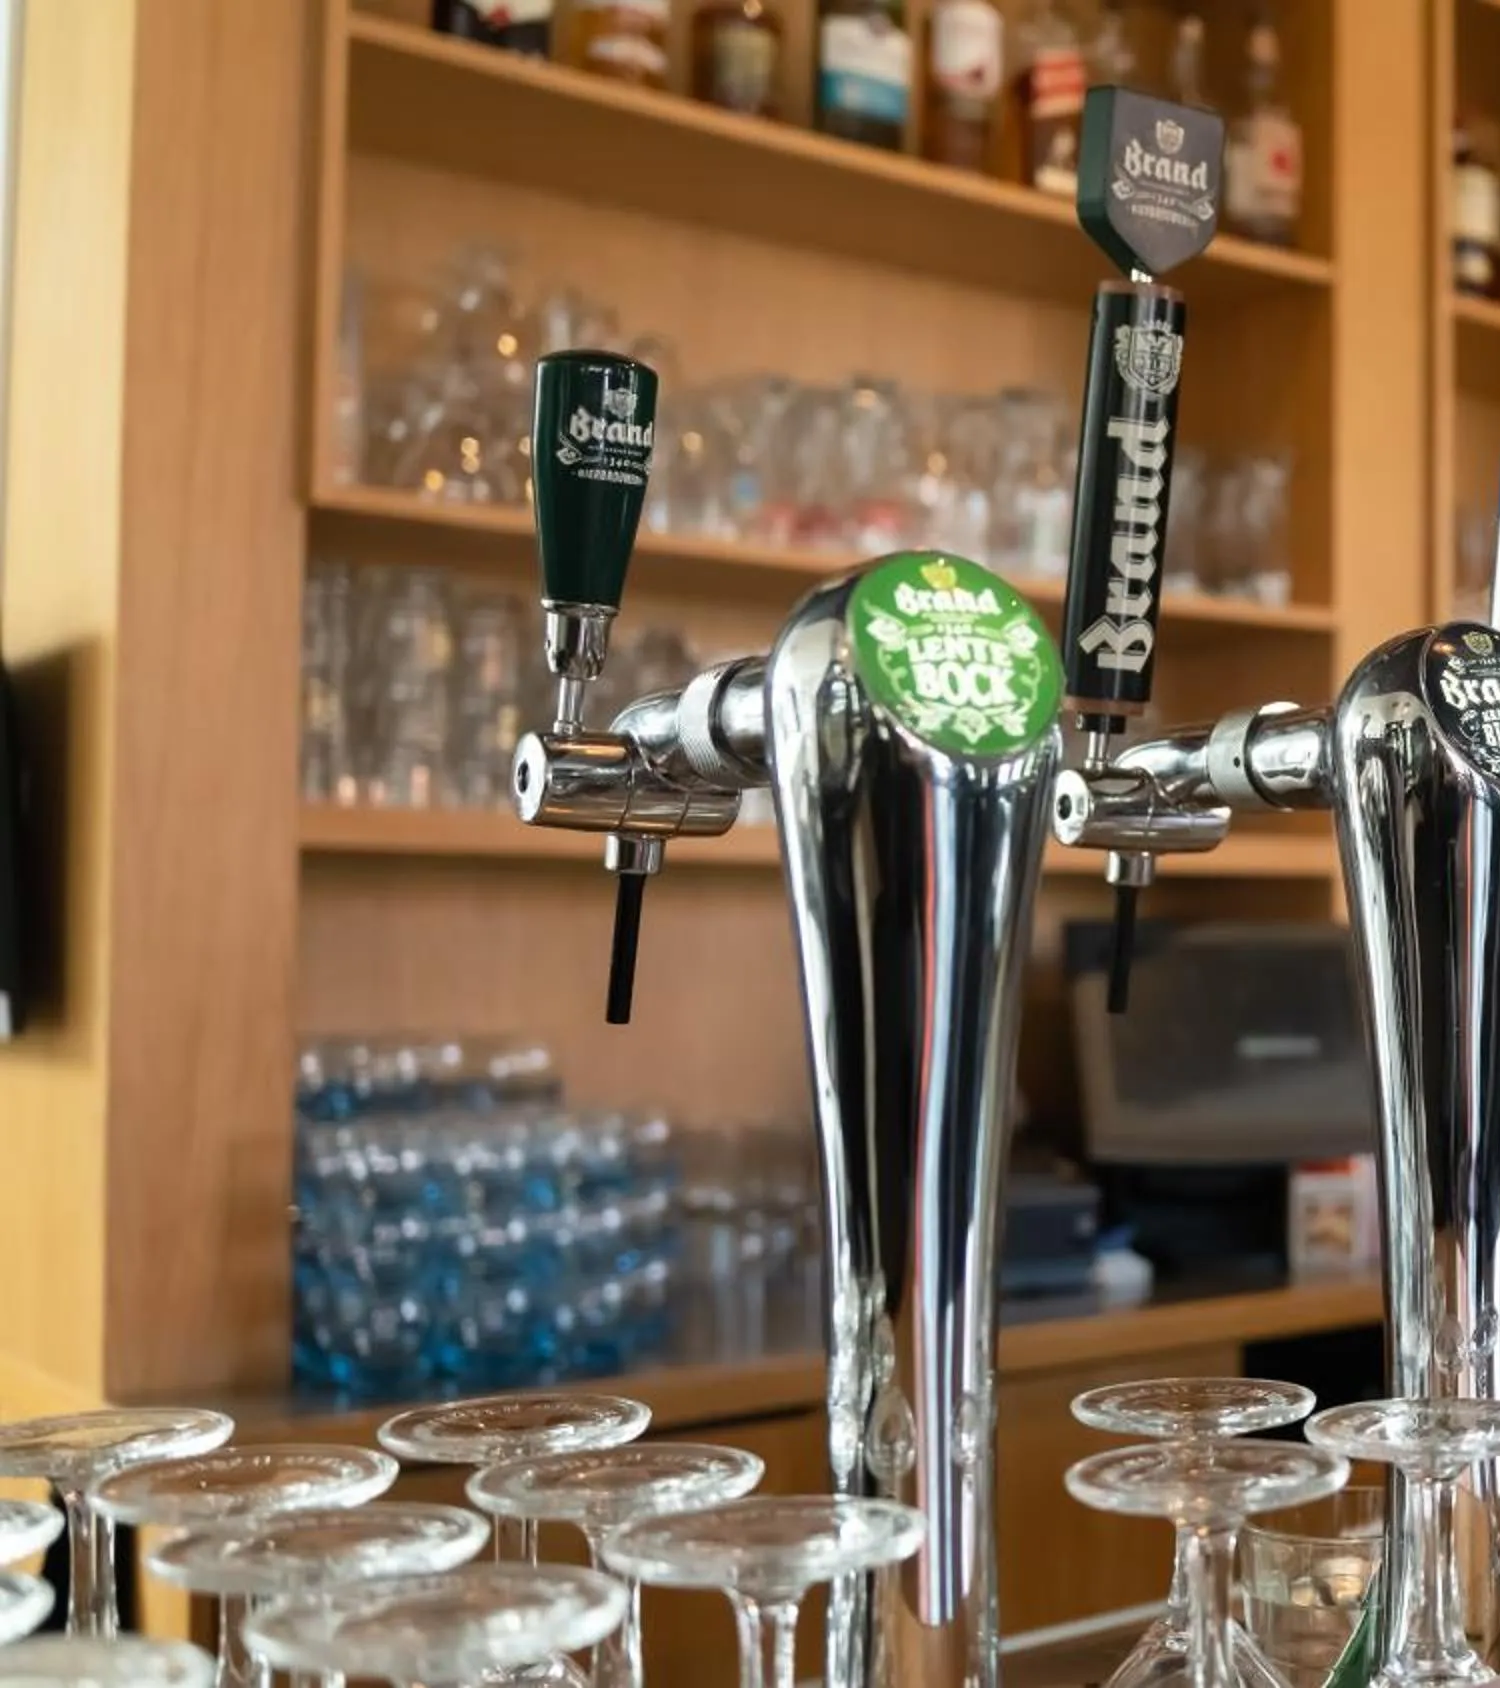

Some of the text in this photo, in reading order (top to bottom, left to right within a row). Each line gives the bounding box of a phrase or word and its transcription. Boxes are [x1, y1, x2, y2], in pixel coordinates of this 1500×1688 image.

[1125, 138, 1208, 190] Brand
[570, 405, 652, 447] Brand
[1078, 416, 1171, 672] Brand
[894, 581, 1003, 616] Brand
[906, 635, 1014, 667] LENTE
[913, 661, 1017, 707] BOCK
